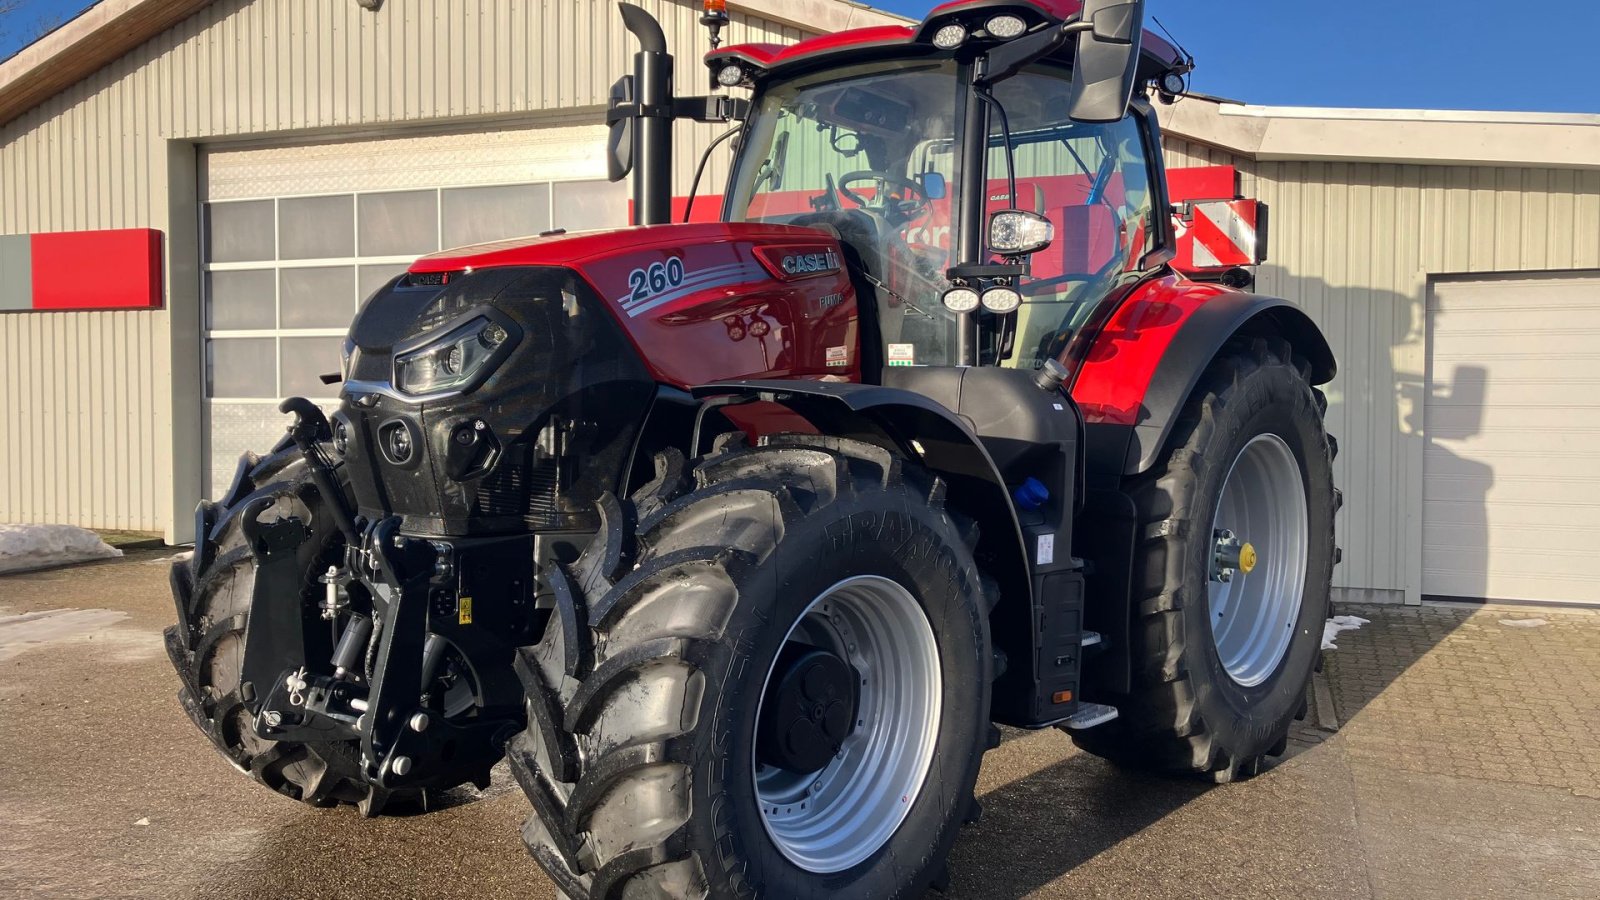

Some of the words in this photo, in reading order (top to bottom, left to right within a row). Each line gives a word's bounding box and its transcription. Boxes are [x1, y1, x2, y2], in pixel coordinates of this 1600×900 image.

[782, 254, 826, 274] CASE
[629, 255, 684, 302] 260
[819, 293, 844, 309] PUMA
